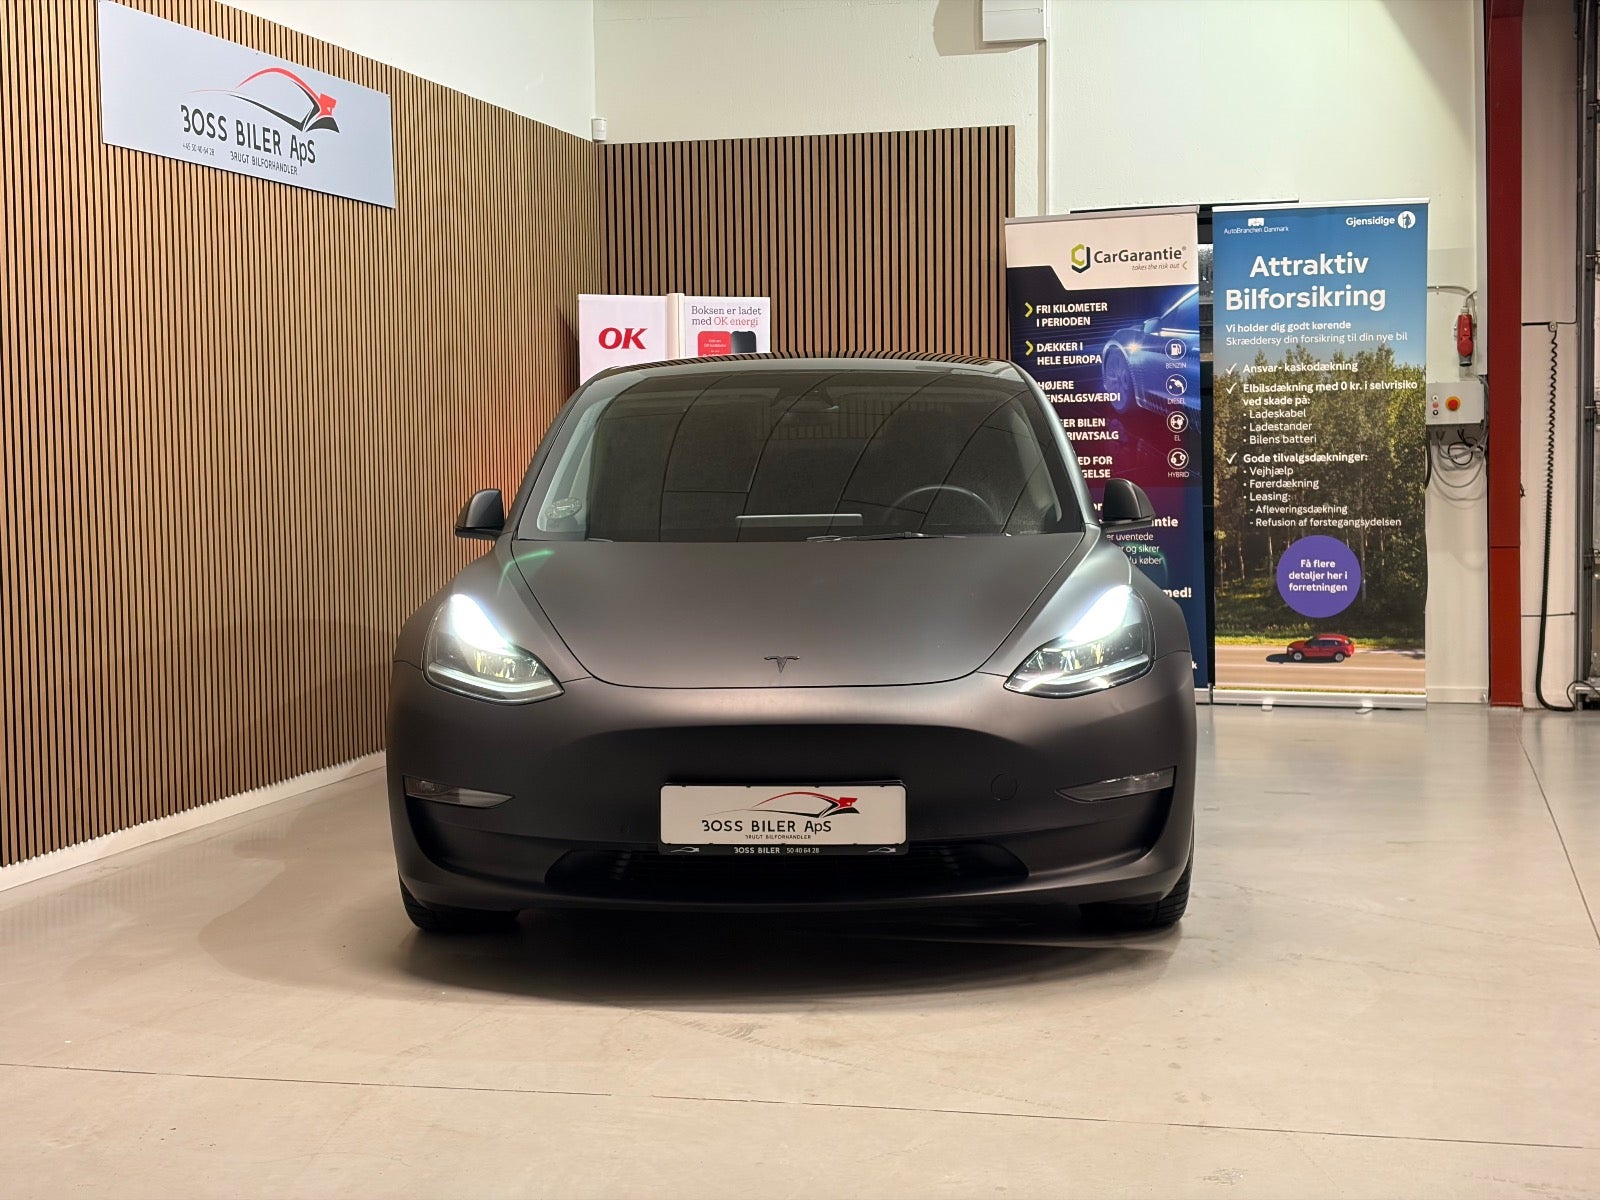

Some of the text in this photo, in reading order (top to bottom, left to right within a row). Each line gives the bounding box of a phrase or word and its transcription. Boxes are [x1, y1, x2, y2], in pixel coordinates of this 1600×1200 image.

[235, 119, 281, 156] BILER
[290, 135, 316, 166] ApS
[252, 156, 298, 175] BILFORHANDLER
[1345, 215, 1396, 228] Gjensidige
[1224, 227, 1262, 235] AutoBranchen
[1093, 247, 1182, 264] CarGarantie
[1249, 251, 1369, 278] Attraktiv
[1226, 284, 1386, 312] Bilforsikring
[691, 305, 762, 316] Boksen er ladet
[1036, 302, 1108, 314] FRI KILOMETER
[691, 316, 759, 328] med OK energi
[1036, 316, 1091, 327] I PERIODEN
[1225, 320, 1352, 333] Vi holder dig godt kørende
[598, 327, 648, 350] OK
[1225, 331, 1408, 346] Skræddersy din forsikring til din nye bil
[1036, 342, 1084, 353] DÆKKER I
[1037, 354, 1103, 366] HELE EUROPA
[1242, 362, 1358, 374] Ansvar- kaskodækning
[1037, 380, 1075, 391] HØJERE
[1243, 380, 1418, 394] Elbilsdækning med 0 kr. i selvrisiko
[1242, 395, 1310, 407] ved skade på:
[1249, 408, 1306, 419] Ladeskabel
[1077, 417, 1106, 428] BILEN
[1249, 421, 1312, 432] Ladestander
[1066, 430, 1119, 441] RIVATSALG
[1249, 433, 1317, 444] Bilens batteri
[1092, 455, 1113, 465] FOR
[1243, 452, 1368, 464] Gode tilvalgsdækninger:
[1249, 466, 1294, 477] Vejhjælp
[1249, 478, 1320, 490] Førerdækning
[1249, 492, 1291, 503] Leasing:
[1255, 504, 1348, 516] Afleveringsdækning
[1255, 517, 1402, 529] Refusion af førstegangsydelsen
[1115, 532, 1154, 541] uventede
[1125, 546, 1137, 555] og
[1138, 543, 1160, 553] sikrer
[1139, 556, 1161, 565] køber
[1300, 559, 1336, 568] Få flere
[1288, 571, 1348, 581] detaljer her i
[1289, 583, 1347, 593] forretningen
[751, 820, 795, 832] BILER
[804, 820, 831, 835] ApS
[795, 846, 803, 854] 40
[803, 846, 811, 854] 64
